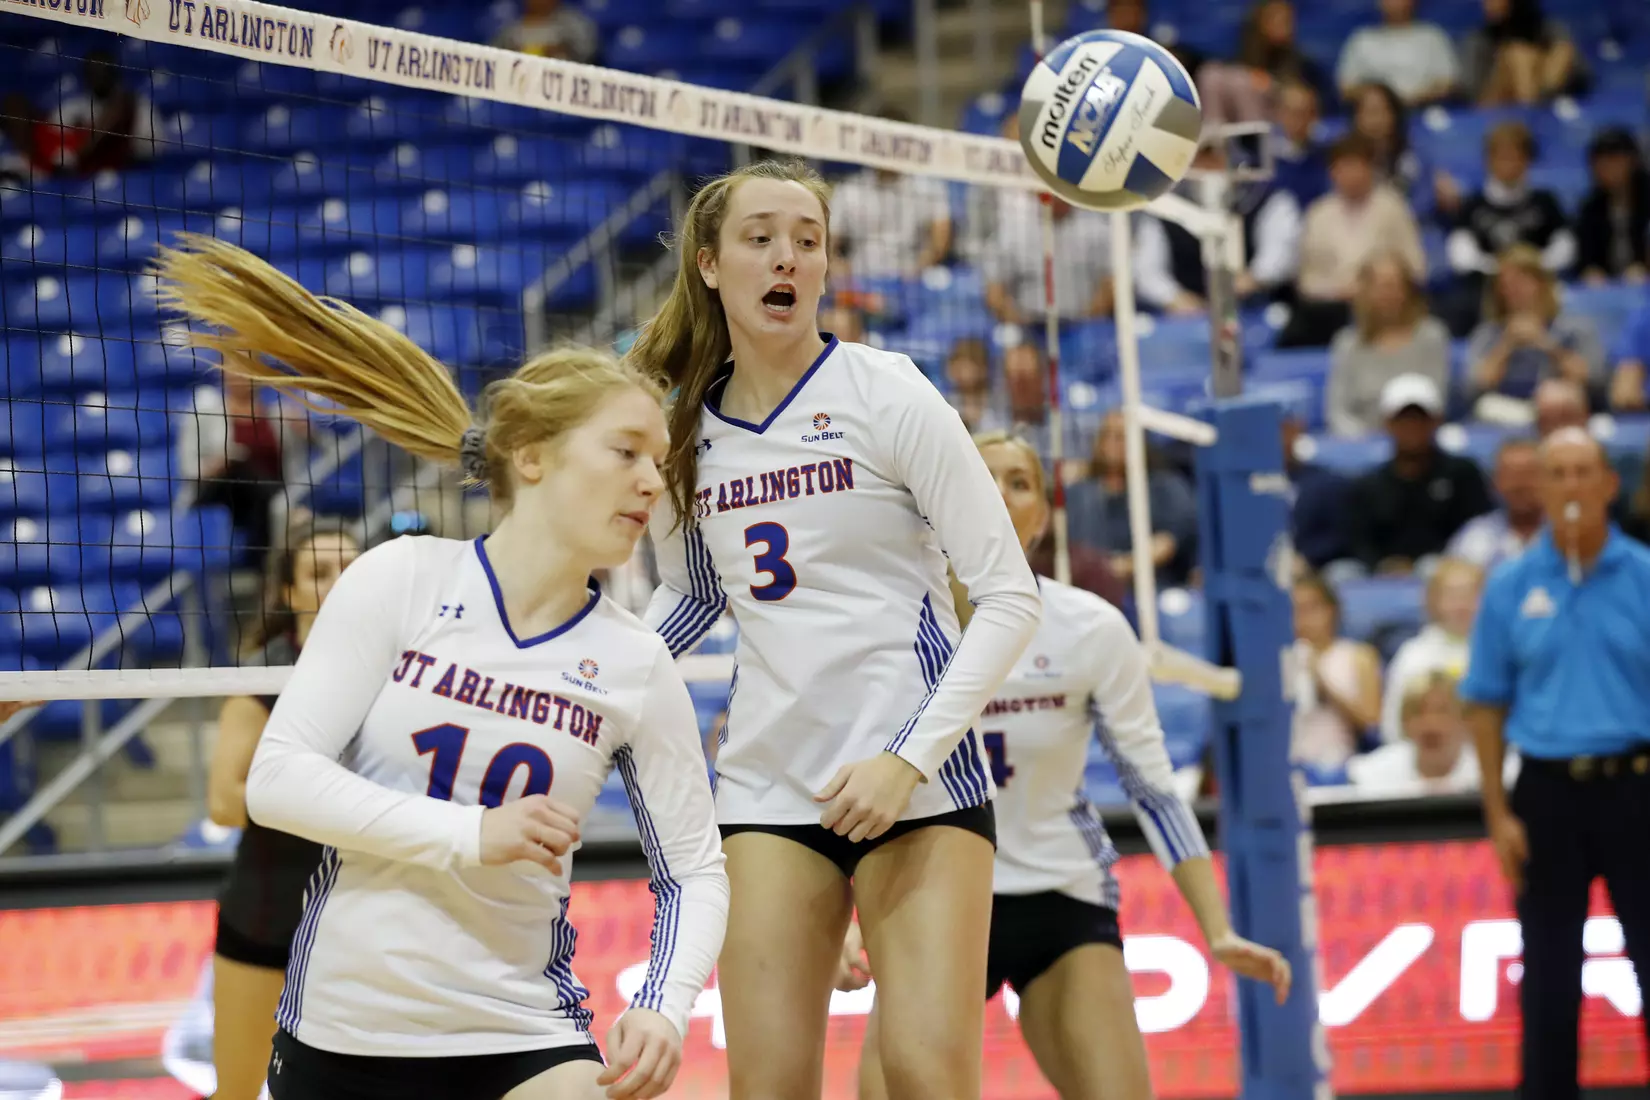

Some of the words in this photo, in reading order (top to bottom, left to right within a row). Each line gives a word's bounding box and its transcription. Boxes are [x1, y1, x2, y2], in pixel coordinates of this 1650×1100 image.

[168, 0, 196, 36] UT
[200, 4, 315, 59] ARLINGTON
[367, 37, 393, 71] UT
[396, 45, 496, 91] ARLINGTON
[1041, 53, 1099, 149] molten
[1066, 72, 1128, 157] NCAA
[716, 457, 855, 513] ARLINGTON
[744, 521, 797, 601] 3
[431, 663, 603, 747] ARLINGTON
[411, 723, 554, 809] 10
